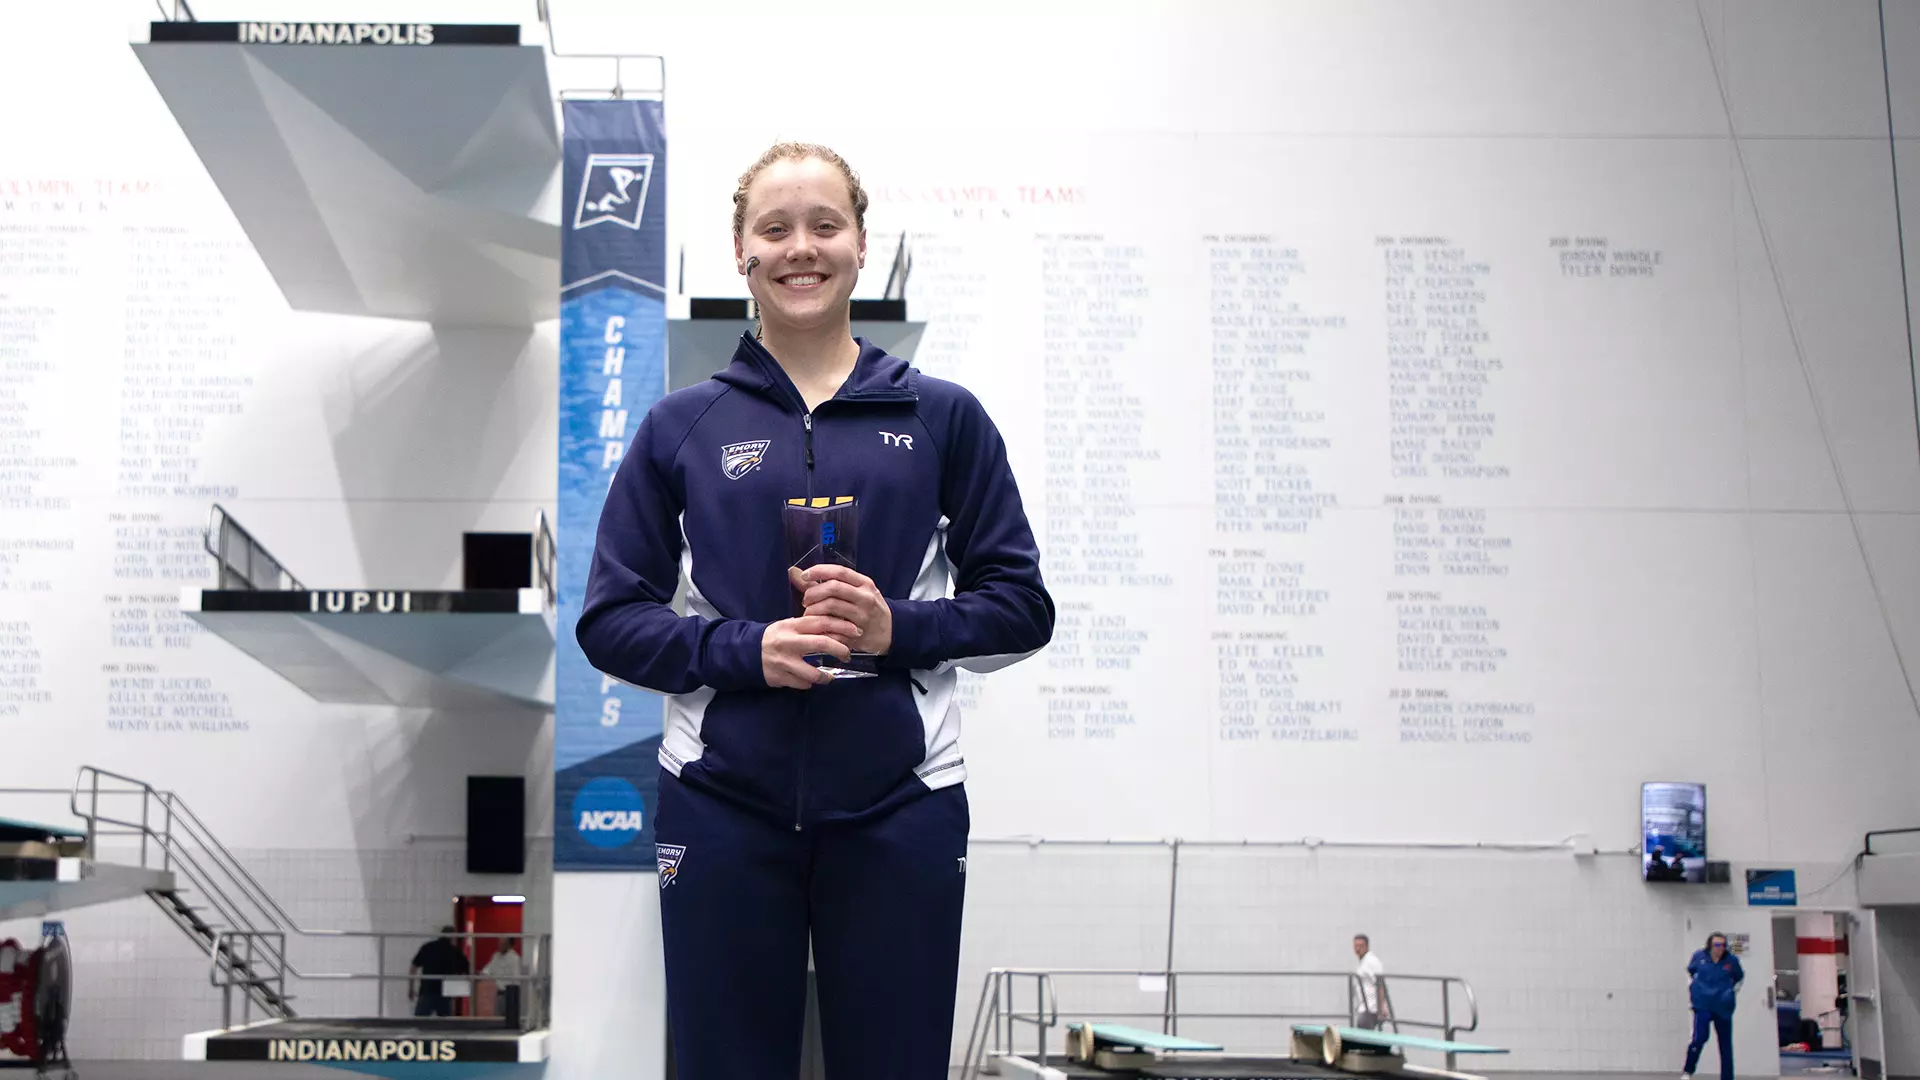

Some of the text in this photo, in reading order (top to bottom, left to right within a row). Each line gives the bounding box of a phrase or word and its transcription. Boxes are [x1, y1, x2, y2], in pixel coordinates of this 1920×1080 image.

[238, 22, 435, 45] INDIANAPOLIS
[728, 442, 766, 453] EMORY
[878, 431, 913, 450] TYR
[309, 591, 411, 613] IUPUI
[578, 810, 643, 831] NCAA
[657, 847, 681, 856] EMORY
[267, 1040, 457, 1061] INDIANAPOLIS
